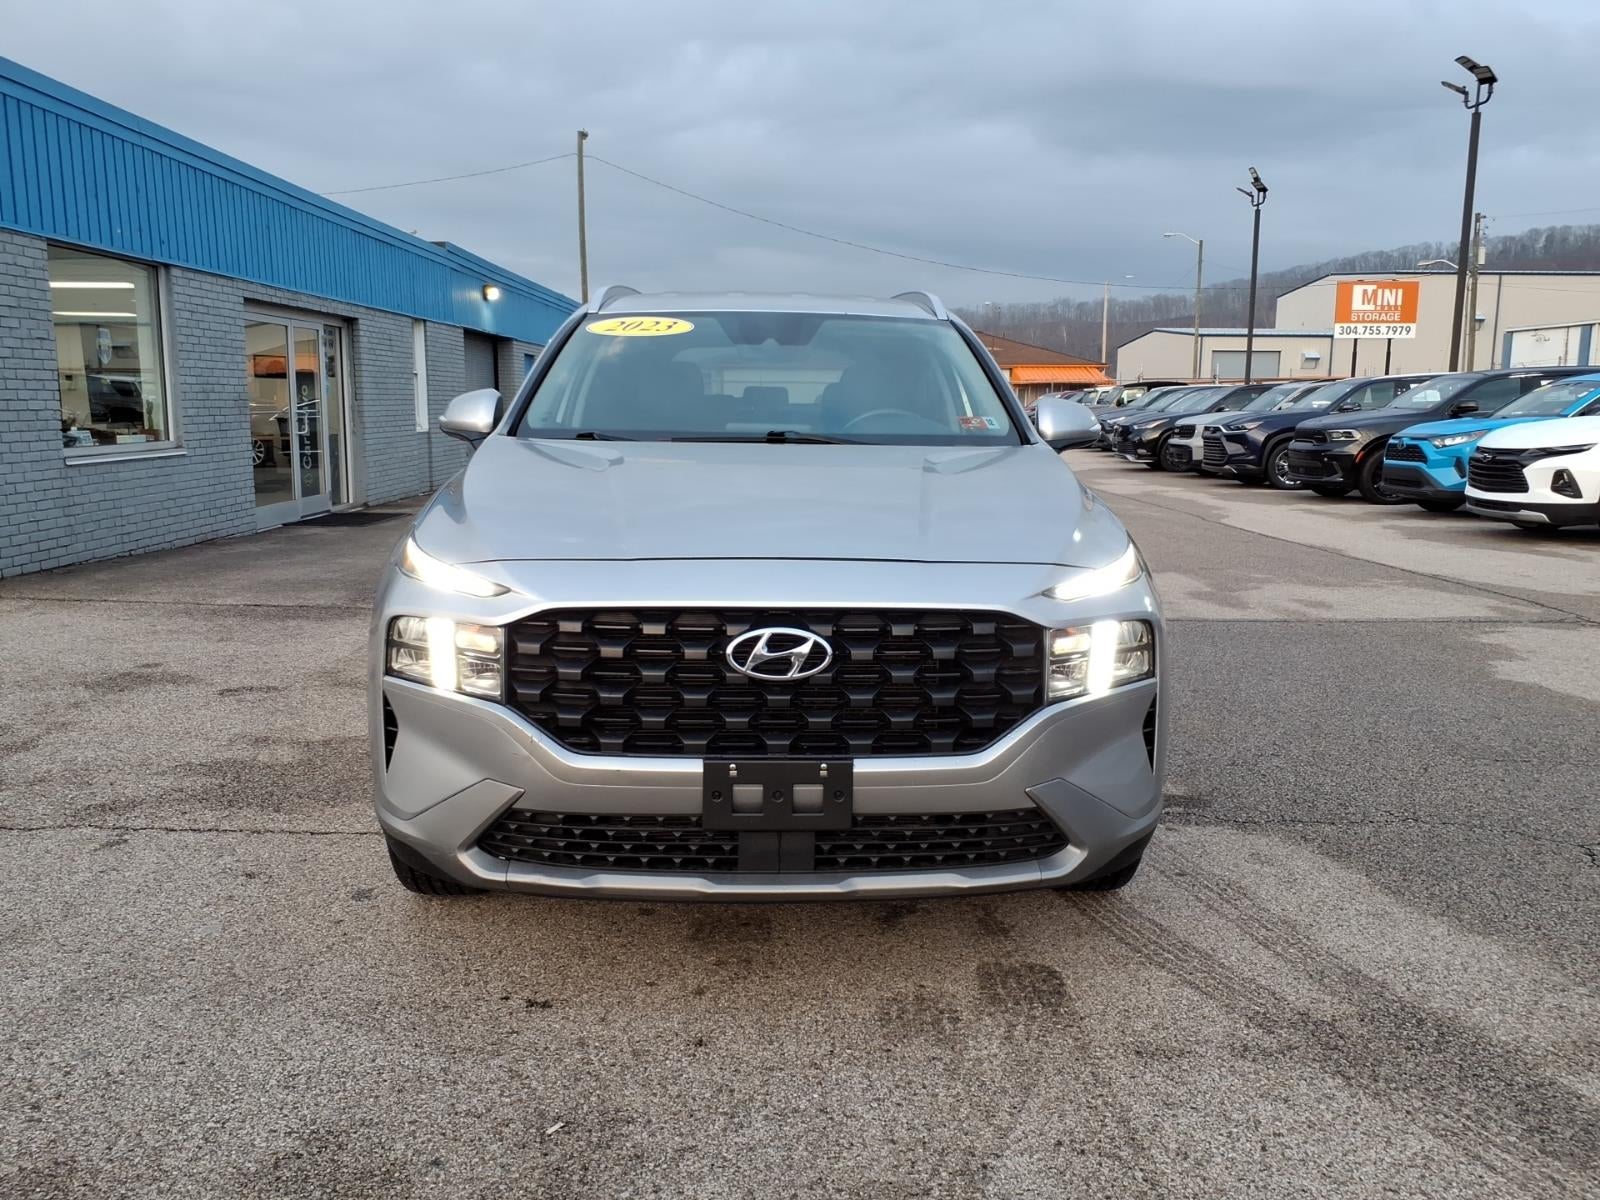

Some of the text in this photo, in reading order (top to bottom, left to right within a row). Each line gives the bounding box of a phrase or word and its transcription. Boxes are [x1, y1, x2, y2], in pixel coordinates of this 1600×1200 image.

[1361, 287, 1403, 306] MINI
[1351, 312, 1401, 321] STORAGE
[603, 320, 678, 332] 2023
[1338, 325, 1412, 336] 304.755.7979
